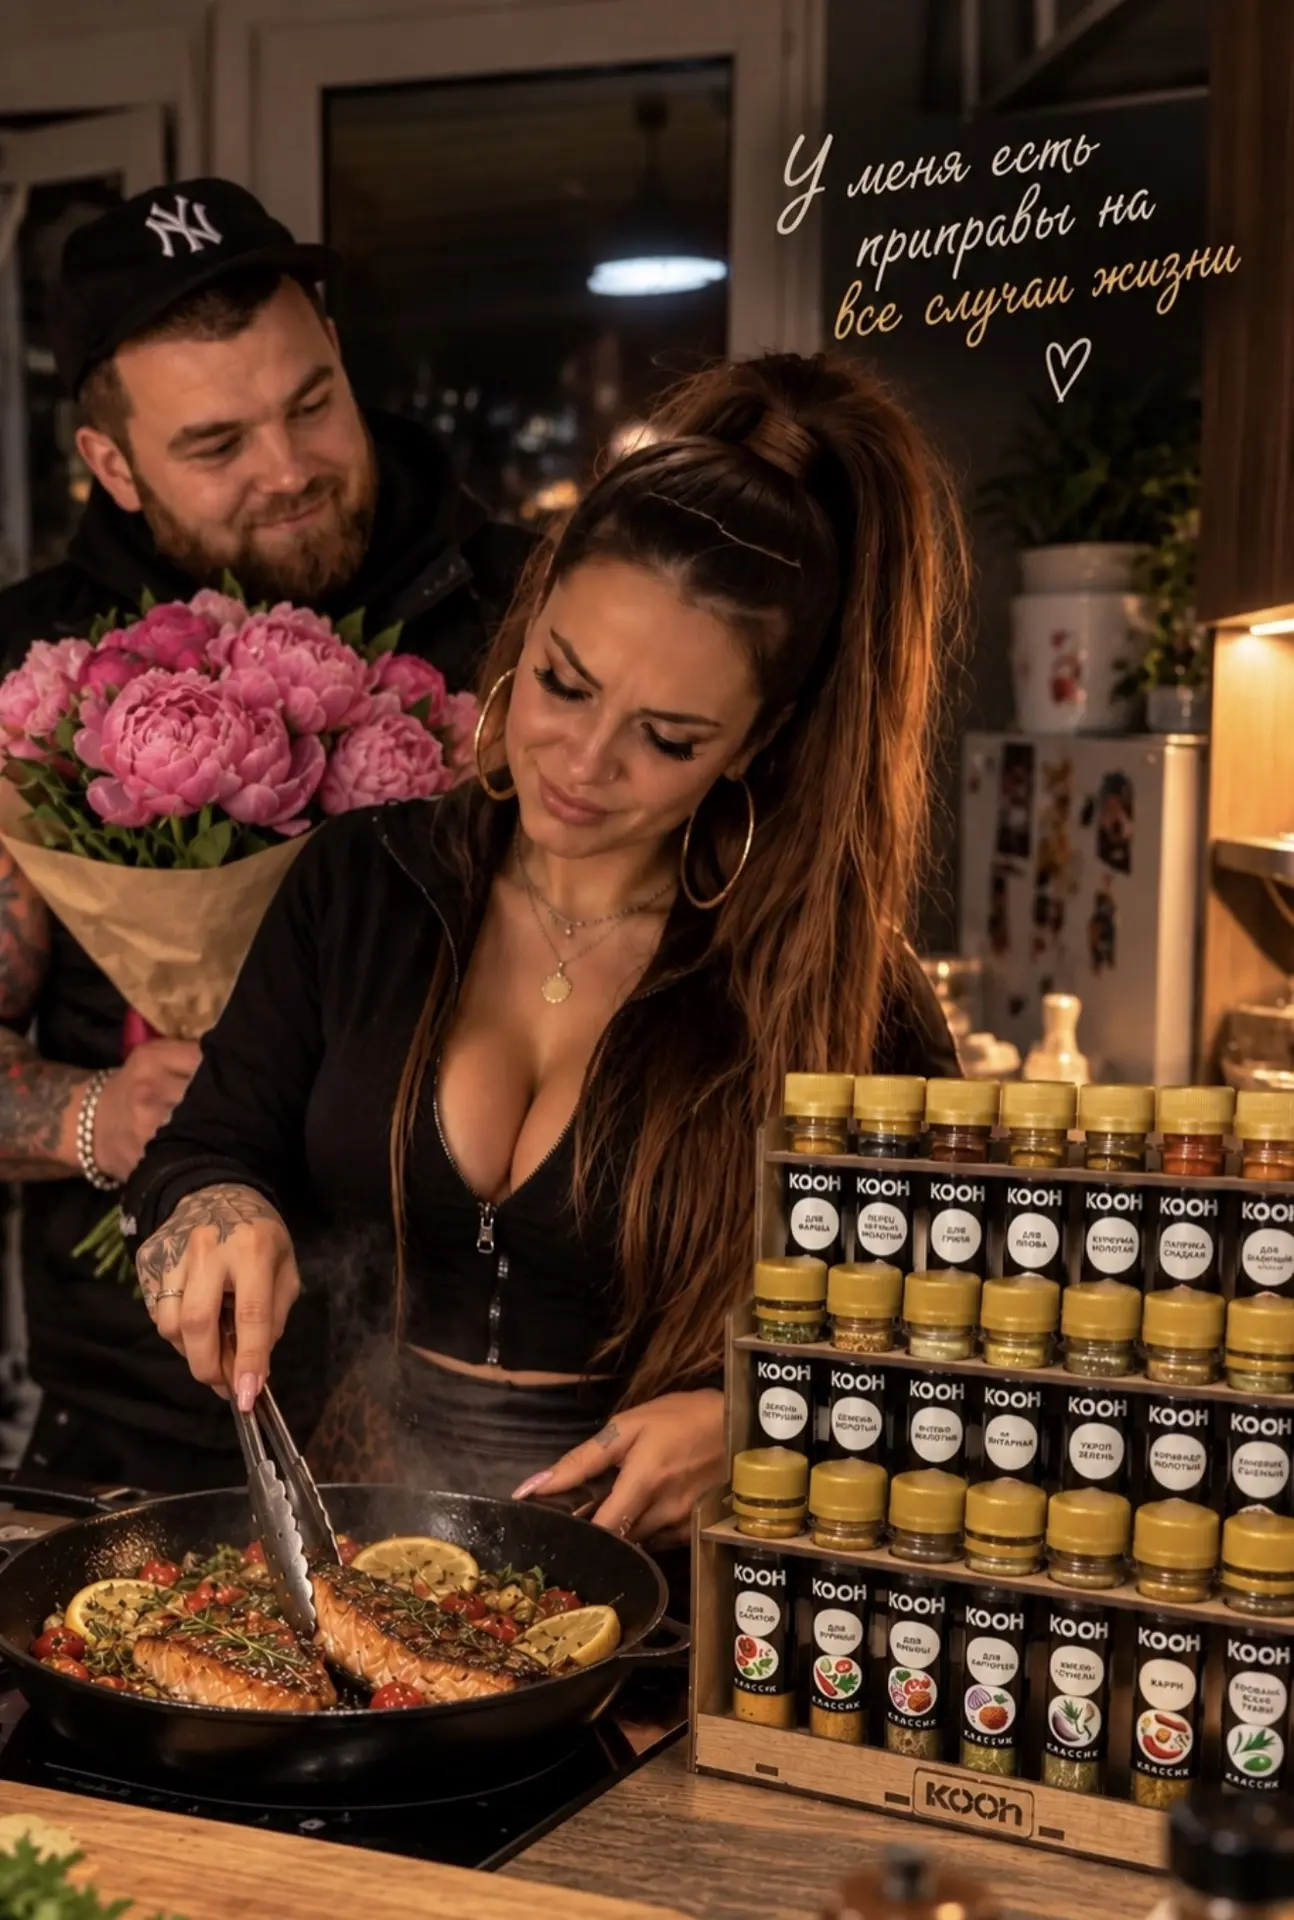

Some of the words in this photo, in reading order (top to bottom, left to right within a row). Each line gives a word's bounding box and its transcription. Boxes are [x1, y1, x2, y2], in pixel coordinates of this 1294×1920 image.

[145, 194, 223, 258] NY
[1080, 1442, 1112, 1451] УКРОП
[1078, 1450, 1114, 1461] ЗЕЛЕНЬ
[1151, 1678, 1184, 1690] КАРРИ
